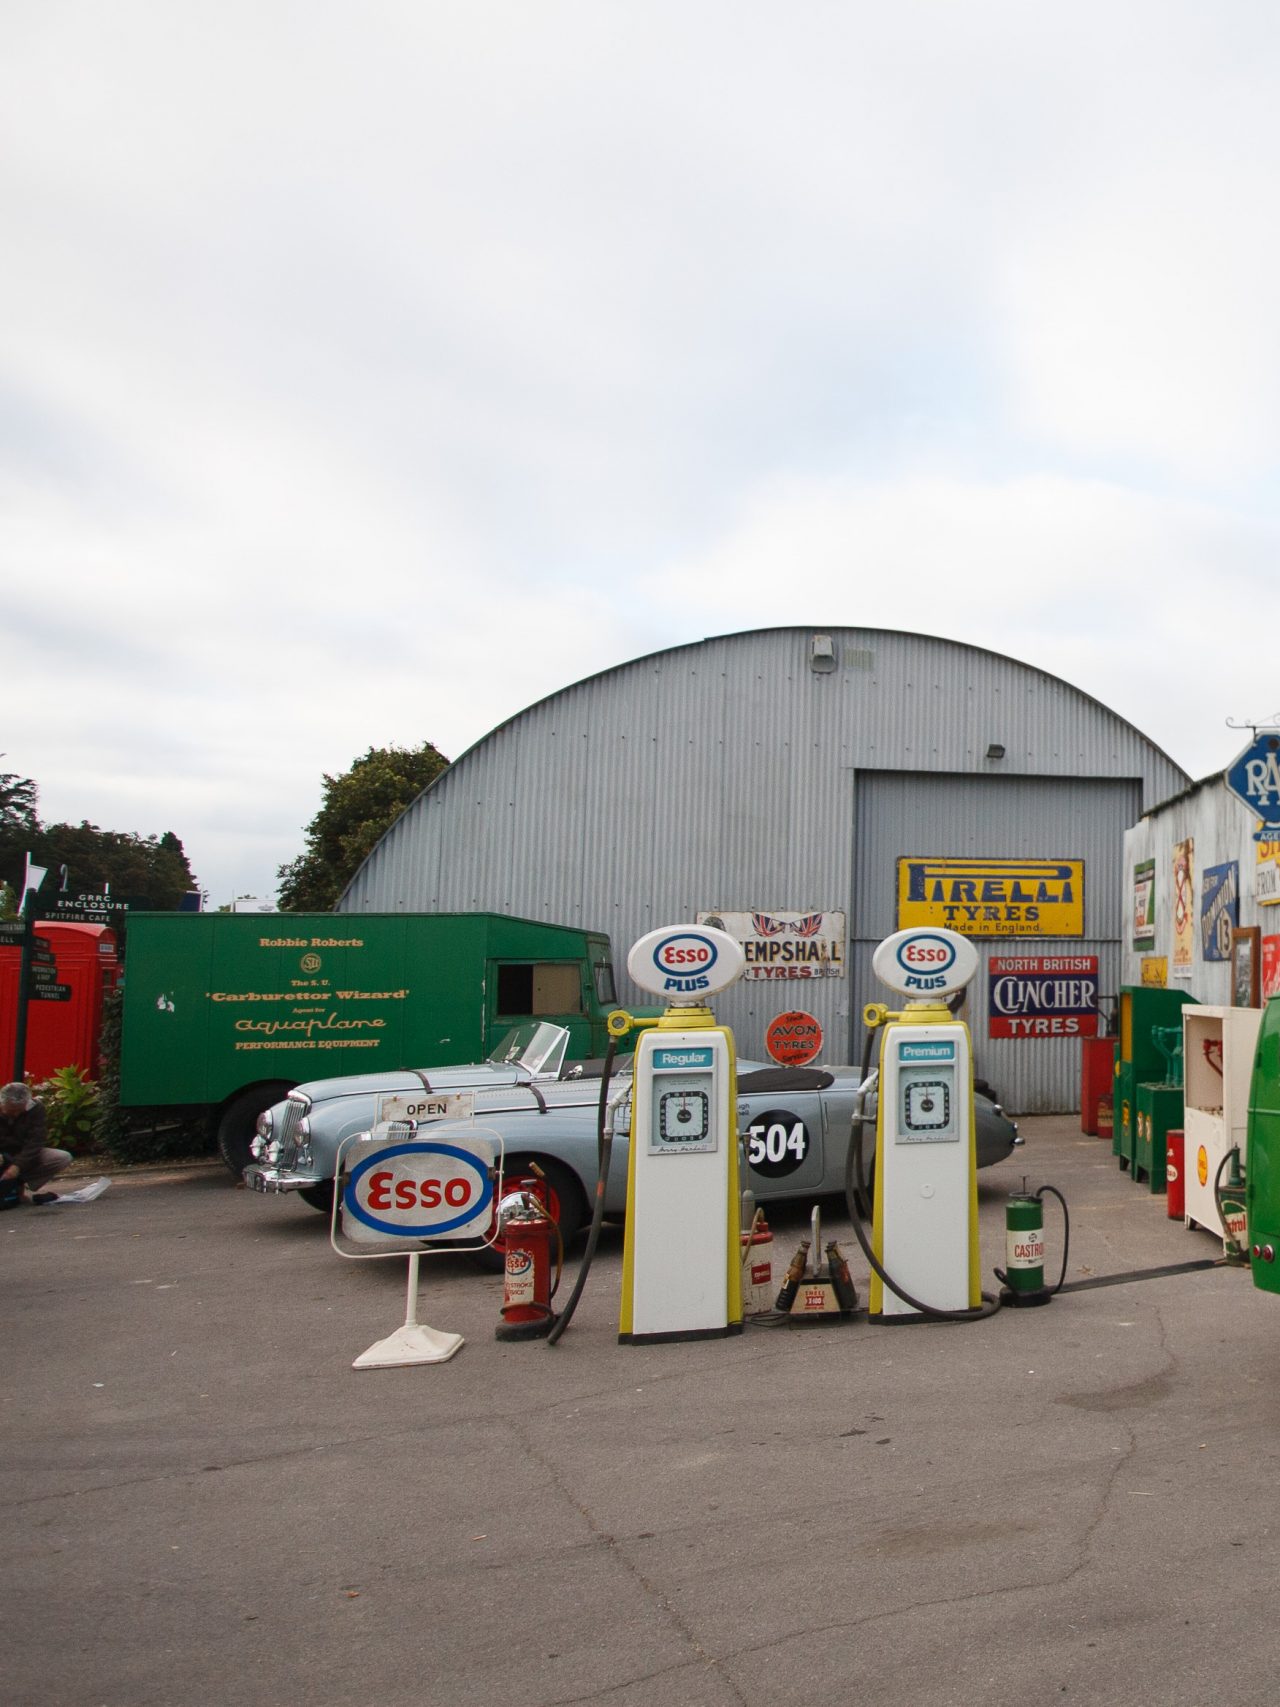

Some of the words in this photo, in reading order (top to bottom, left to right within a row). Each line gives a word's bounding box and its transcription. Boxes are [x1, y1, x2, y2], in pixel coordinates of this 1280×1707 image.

[907, 863, 1074, 903] PIRELLI
[78, 894, 111, 902] GRRC
[57, 900, 130, 910] ENCLOSURE
[45, 911, 85, 920] SPITFIRE
[942, 905, 1040, 921] TYRES
[943, 922, 974, 932] Made
[979, 922, 990, 932] in
[259, 938, 308, 947] Robbie
[311, 938, 364, 947] Roberts
[997, 959, 1038, 971] NORTH
[1043, 959, 1091, 971] BRITISH
[751, 966, 812, 979] TYRES
[663, 975, 710, 992] PLUS
[904, 975, 947, 990] PLUS
[993, 976, 1096, 1014] CLINCHER
[771, 1025, 817, 1036] AVON
[1007, 1017, 1080, 1034] TYRES
[235, 1040, 316, 1050] PERFORMANCE
[318, 1039, 380, 1049] EQUIPMENT
[773, 1040, 815, 1049] TYRES
[903, 1046, 951, 1057] Premium
[662, 1051, 707, 1066] Regular
[406, 1103, 448, 1116] OPEN
[748, 1122, 806, 1164] 504
